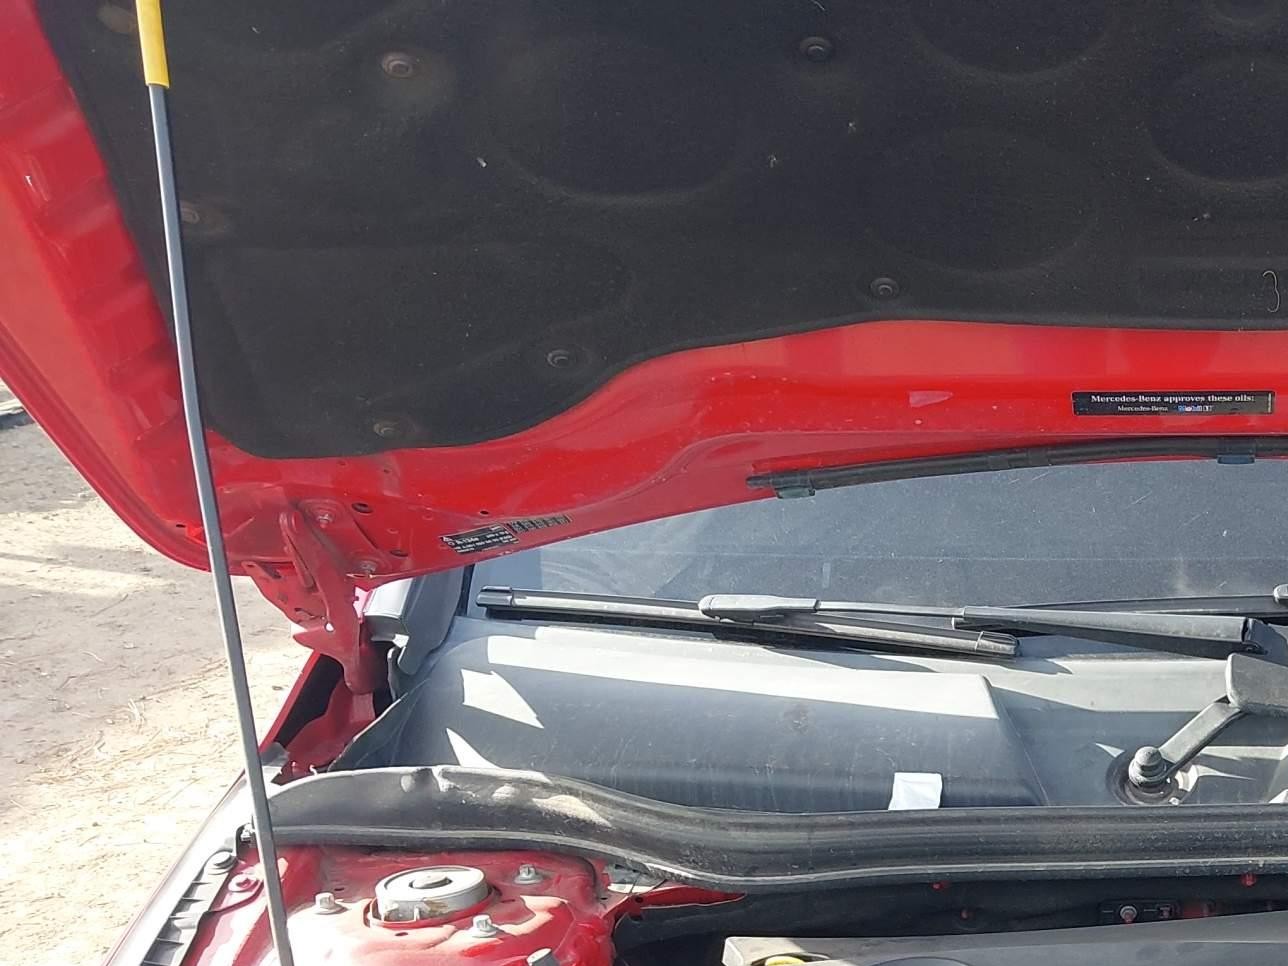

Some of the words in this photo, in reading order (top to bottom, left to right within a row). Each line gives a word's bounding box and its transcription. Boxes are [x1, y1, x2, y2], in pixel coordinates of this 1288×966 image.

[1091, 395, 1161, 403] Mercedes-Benz
[1163, 395, 1205, 404] approves
[1207, 394, 1233, 402] these
